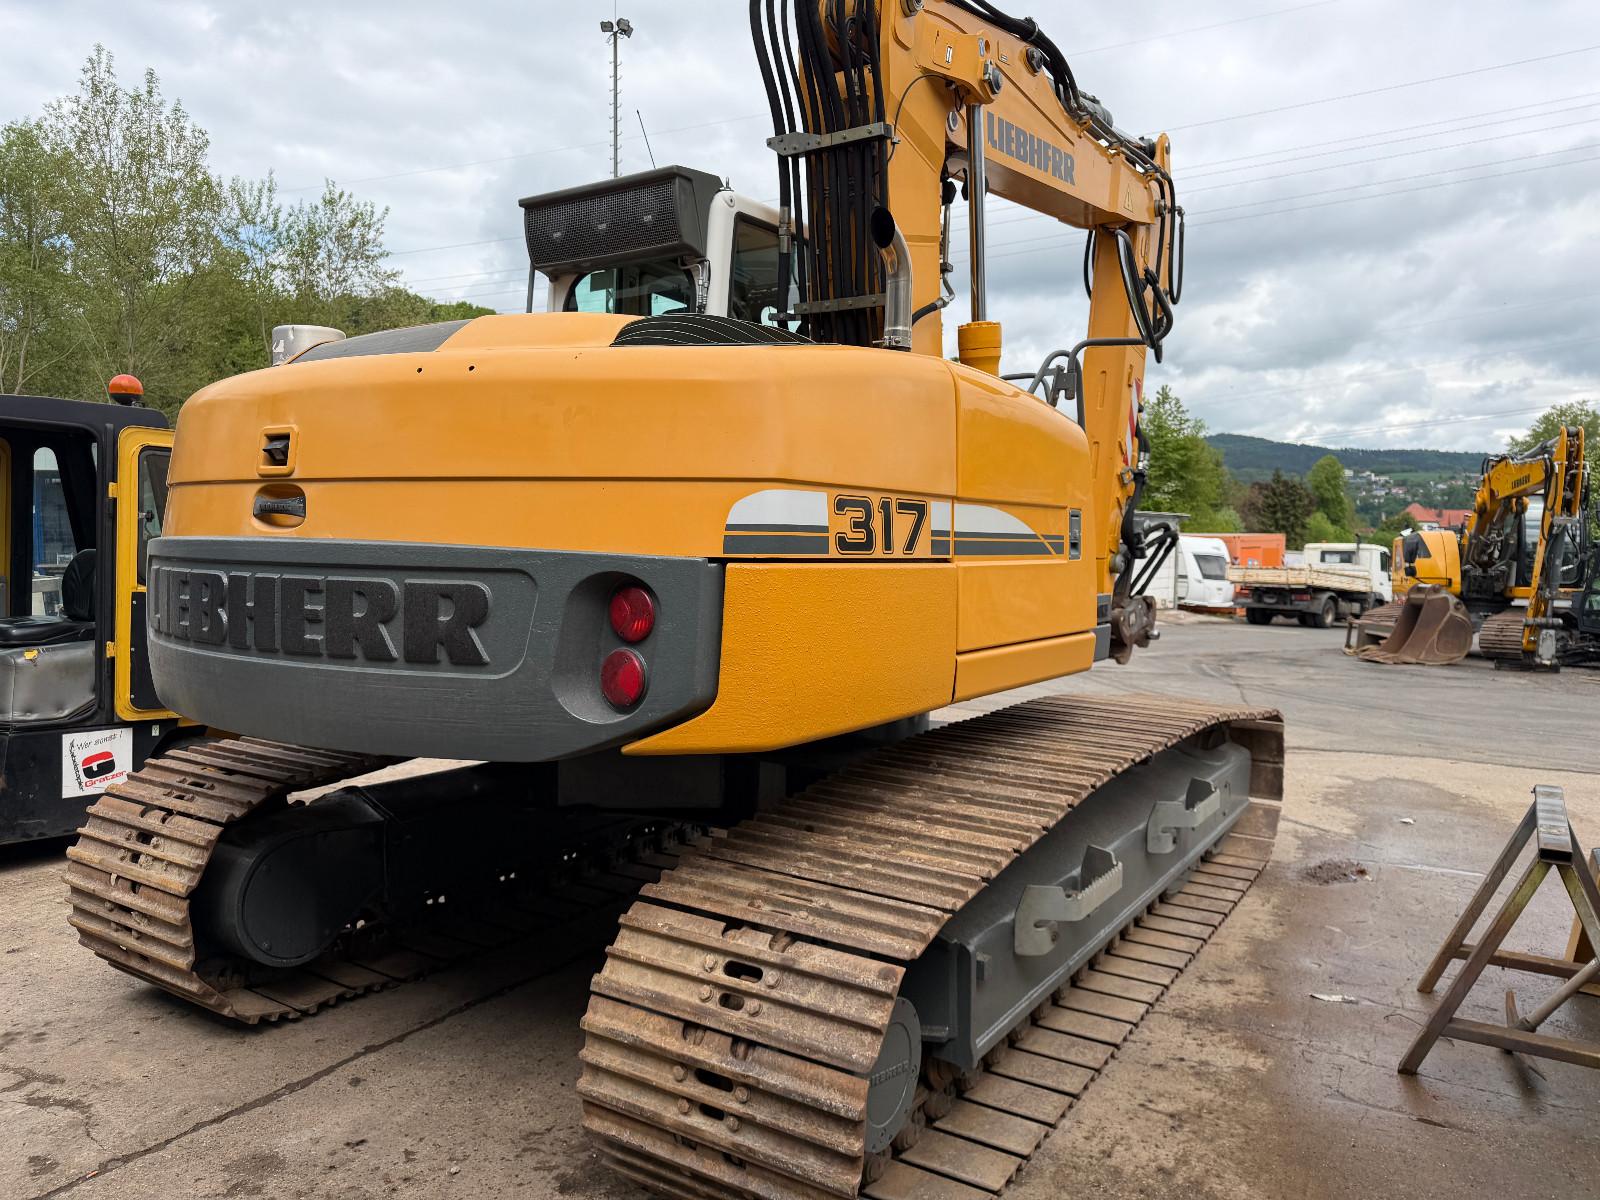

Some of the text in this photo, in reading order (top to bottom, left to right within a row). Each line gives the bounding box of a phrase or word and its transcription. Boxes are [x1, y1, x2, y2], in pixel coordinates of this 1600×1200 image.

[834, 494, 928, 555] 317
[150, 565, 492, 666] LIEBHERR
[84, 770, 127, 788] Gratzer
